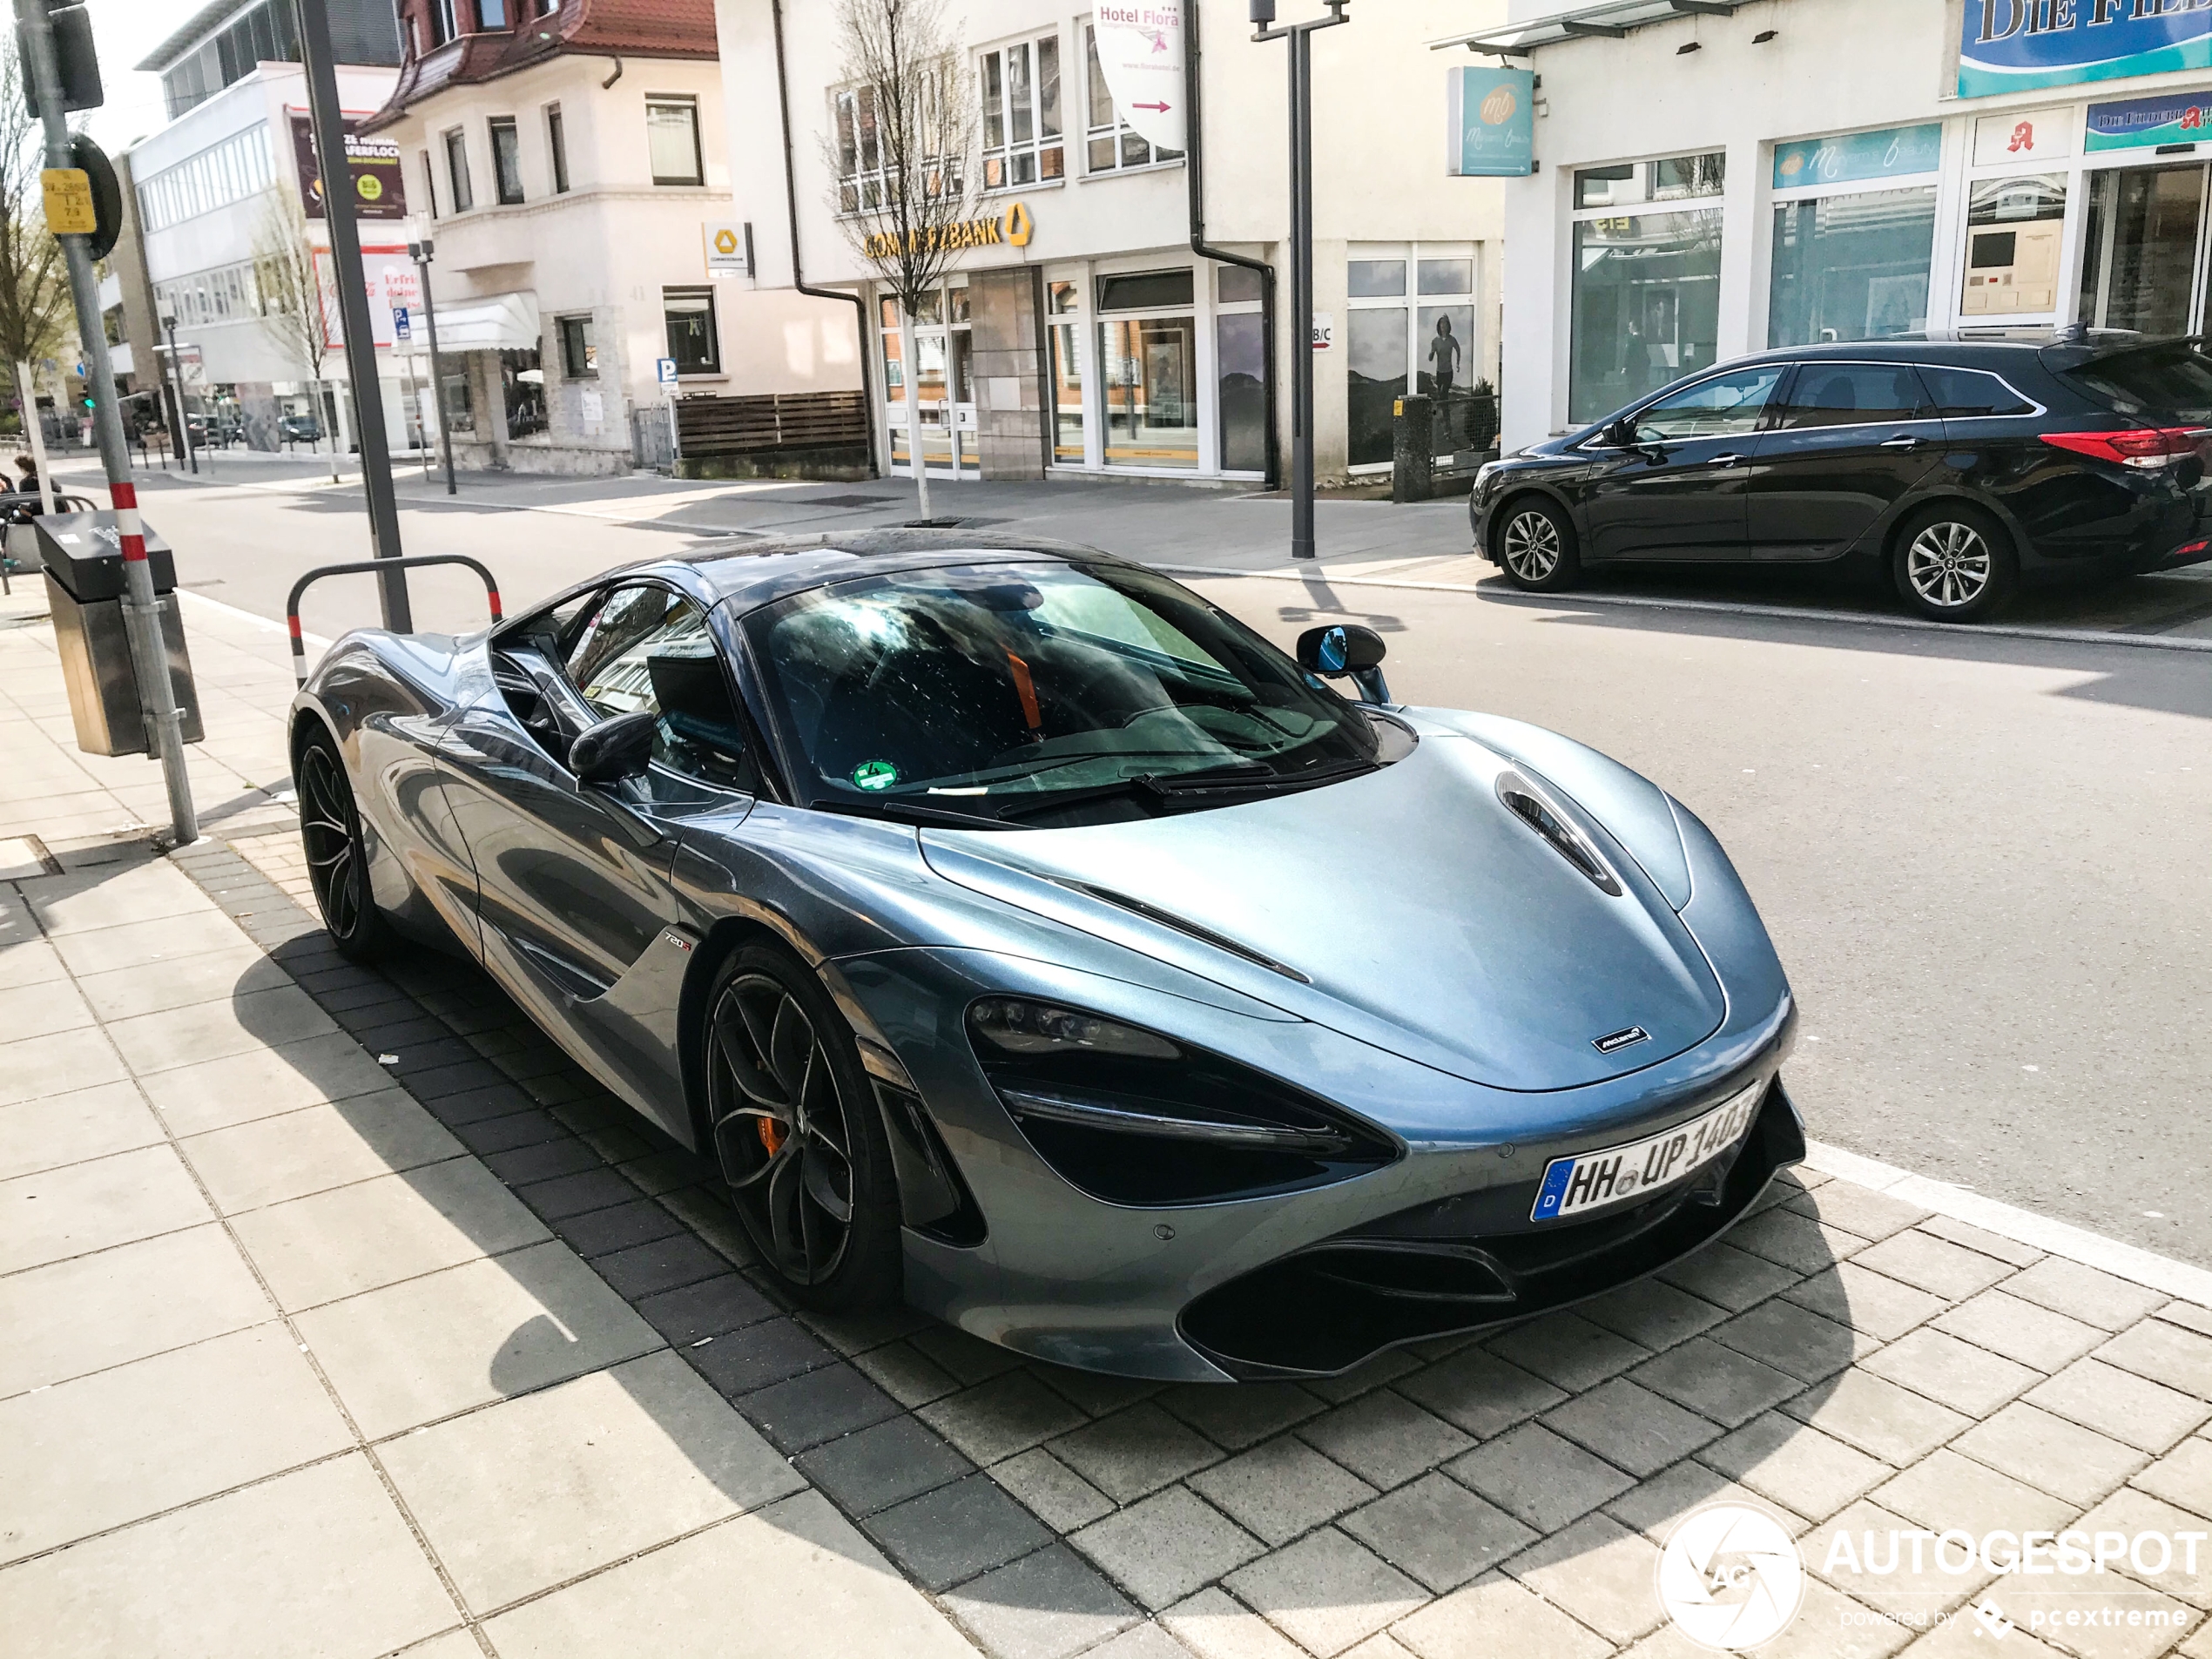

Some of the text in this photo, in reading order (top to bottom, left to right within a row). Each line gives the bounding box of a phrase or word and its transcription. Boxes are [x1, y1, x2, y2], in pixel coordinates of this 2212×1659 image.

[1100, 6, 1138, 23] Hotel
[1143, 10, 1178, 26] Flora
[1975, 0, 2076, 44] DIE
[2098, 114, 2123, 127] DIE
[661, 360, 676, 381] P
[868, 763, 880, 775] 4
[664, 931, 691, 952] 720S
[1602, 1031, 1640, 1049] McLaren
[1565, 1156, 1623, 1207] HH
[1641, 1132, 1688, 1187] UP
[1543, 1194, 1556, 1208] D
